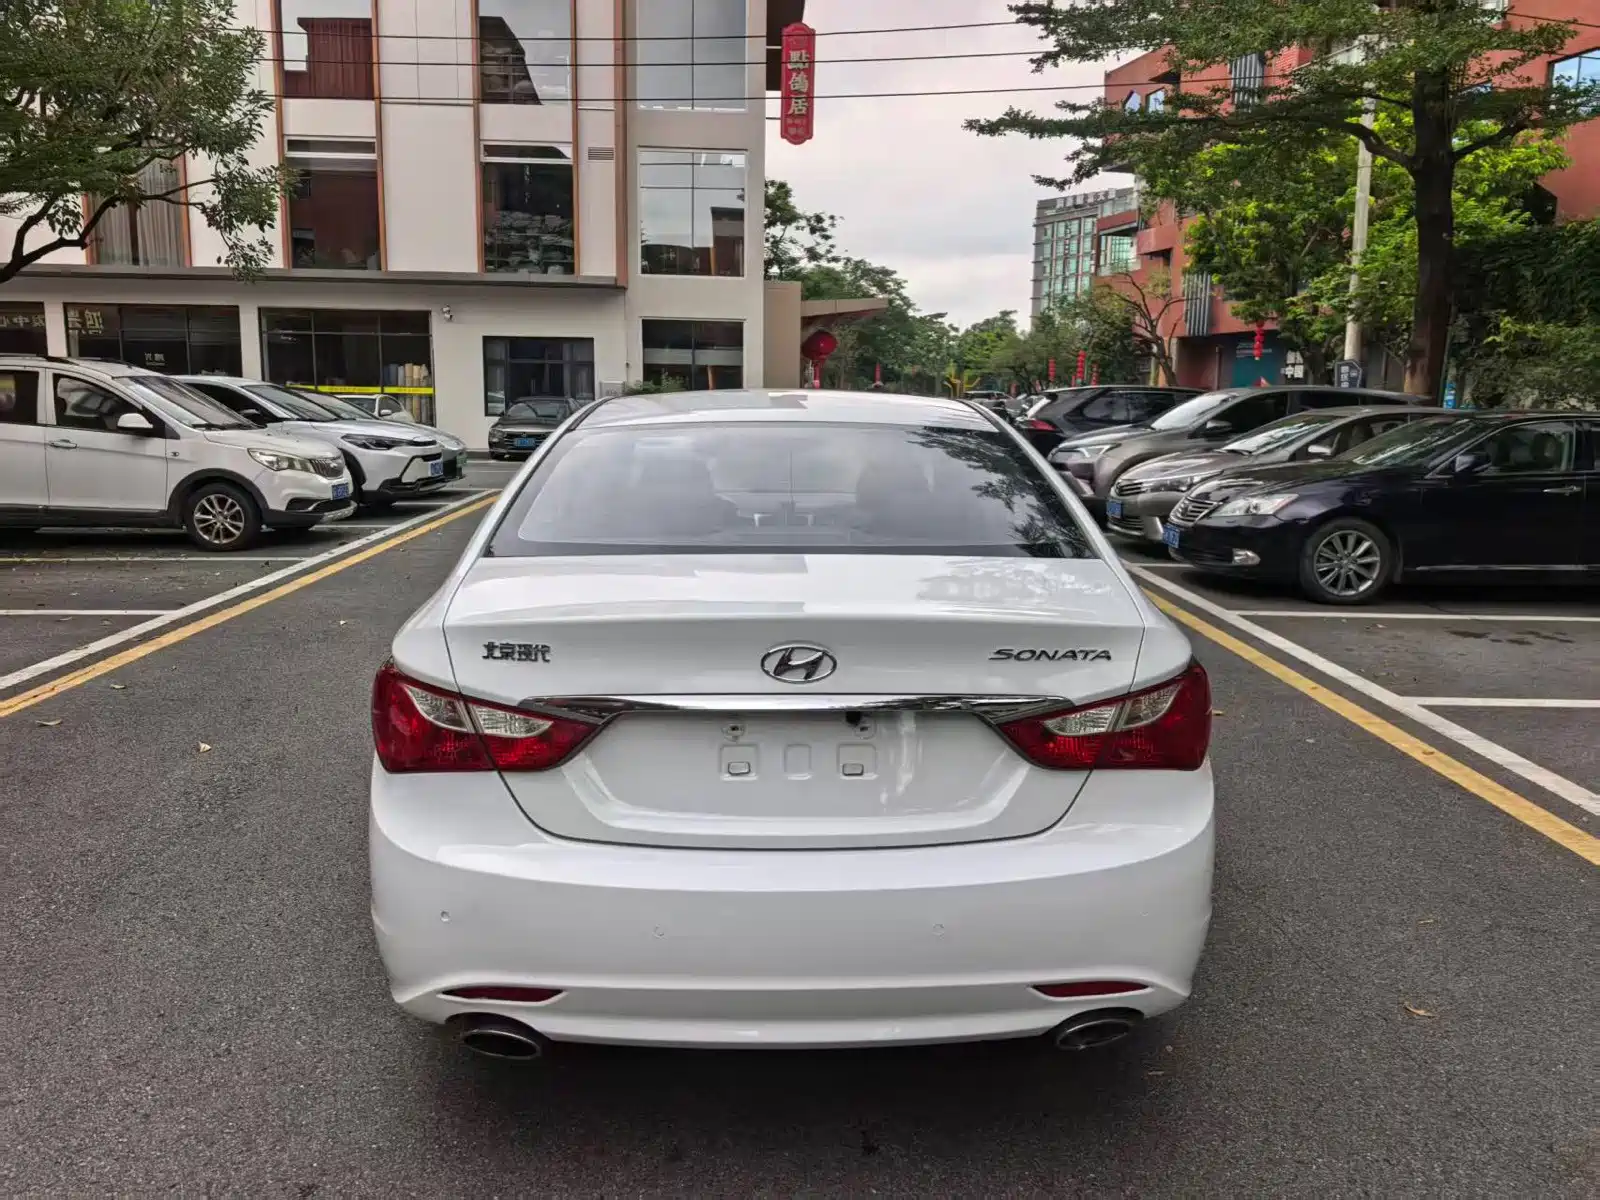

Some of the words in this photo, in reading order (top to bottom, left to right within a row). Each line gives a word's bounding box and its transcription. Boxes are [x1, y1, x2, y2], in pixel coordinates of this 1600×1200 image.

[482, 641, 551, 663] 北京现代
[988, 648, 1112, 661] SONATA
